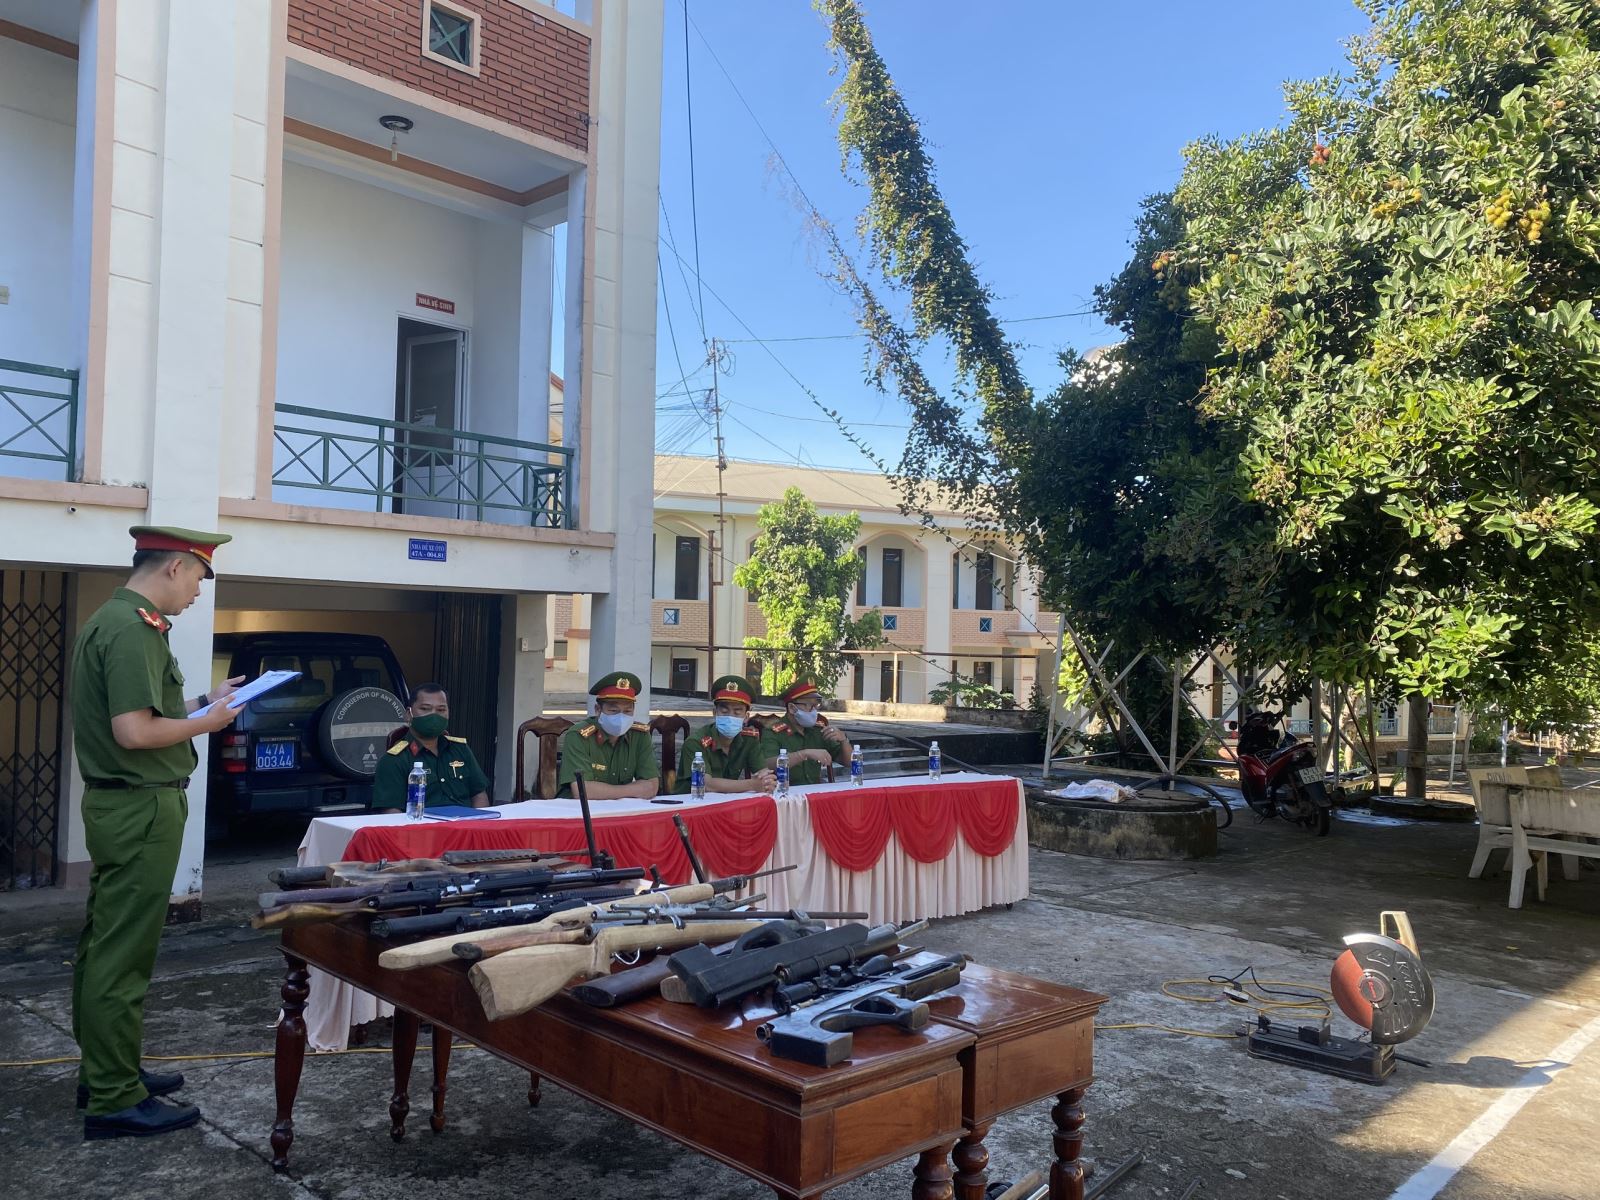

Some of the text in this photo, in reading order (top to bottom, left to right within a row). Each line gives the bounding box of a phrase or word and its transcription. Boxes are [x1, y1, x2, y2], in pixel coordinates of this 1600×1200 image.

[337, 692, 370, 720] CONQUEROR
[380, 693, 392, 702] ANY
[265, 743, 285, 755] 47A
[257, 755, 292, 768] 003.44
